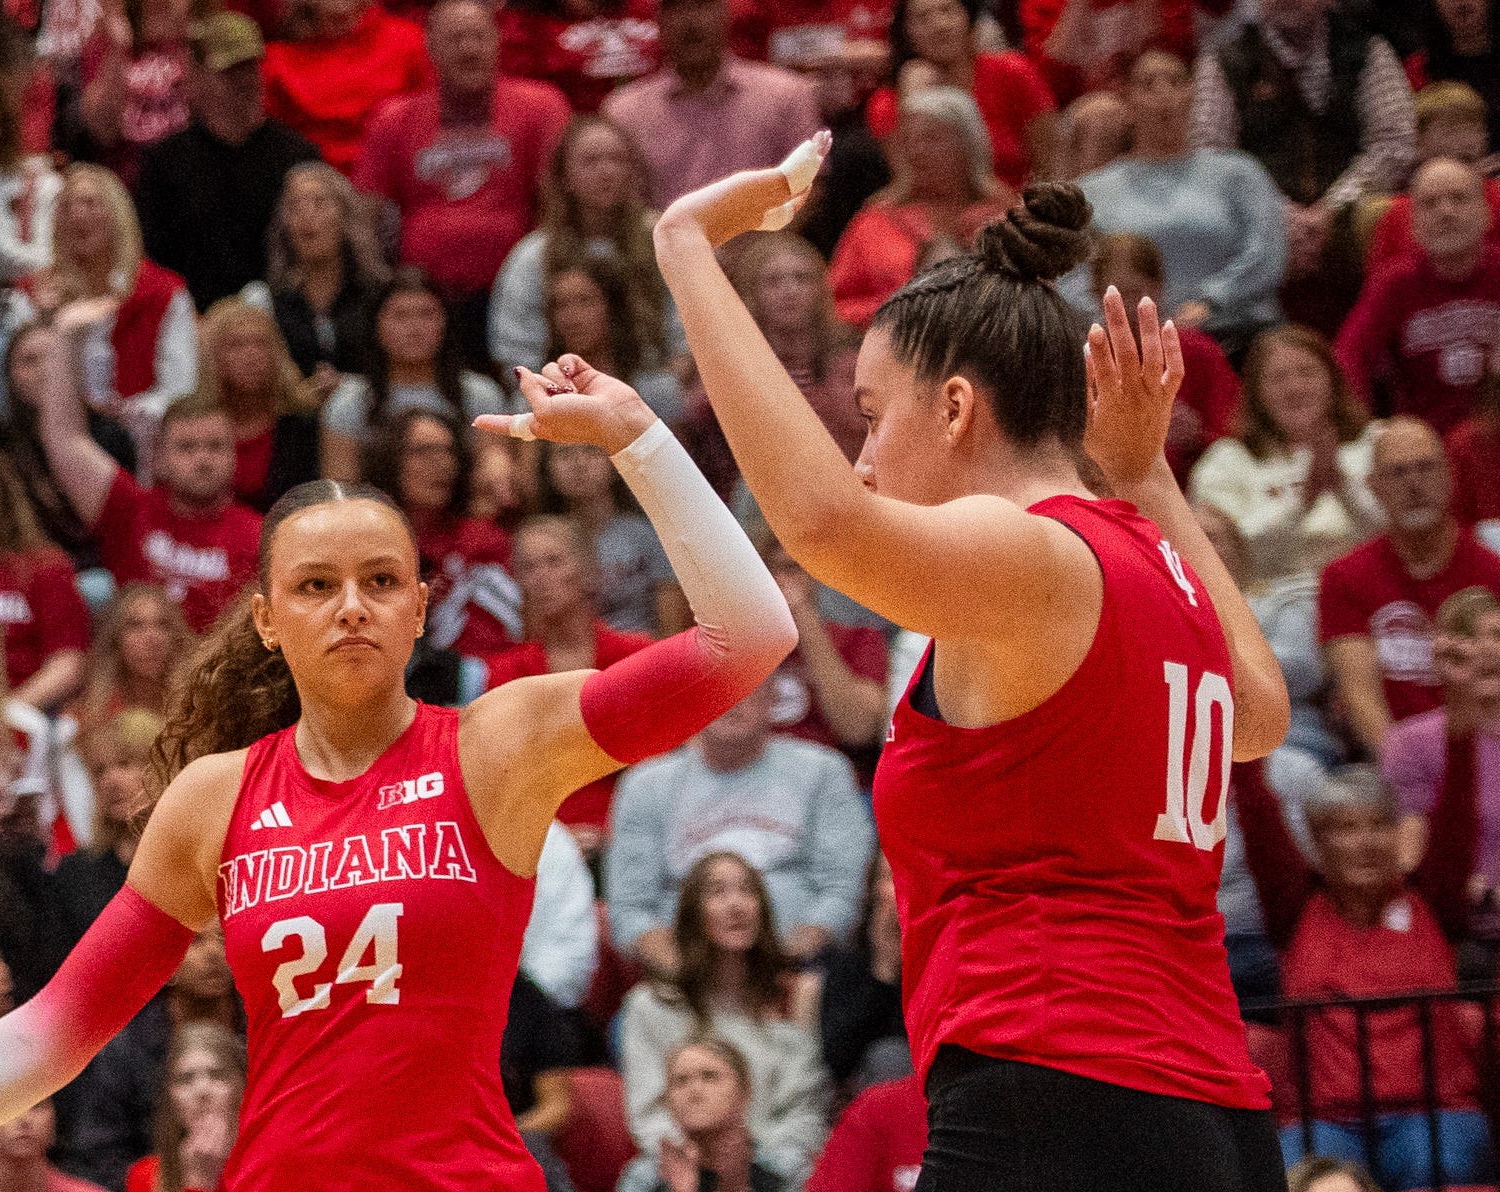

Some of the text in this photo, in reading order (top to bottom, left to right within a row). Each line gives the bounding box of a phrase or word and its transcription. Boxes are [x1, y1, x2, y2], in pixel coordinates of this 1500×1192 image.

[1153, 660, 1235, 851] 10
[218, 821, 478, 921] INDIANA
[261, 902, 404, 1019] 24
